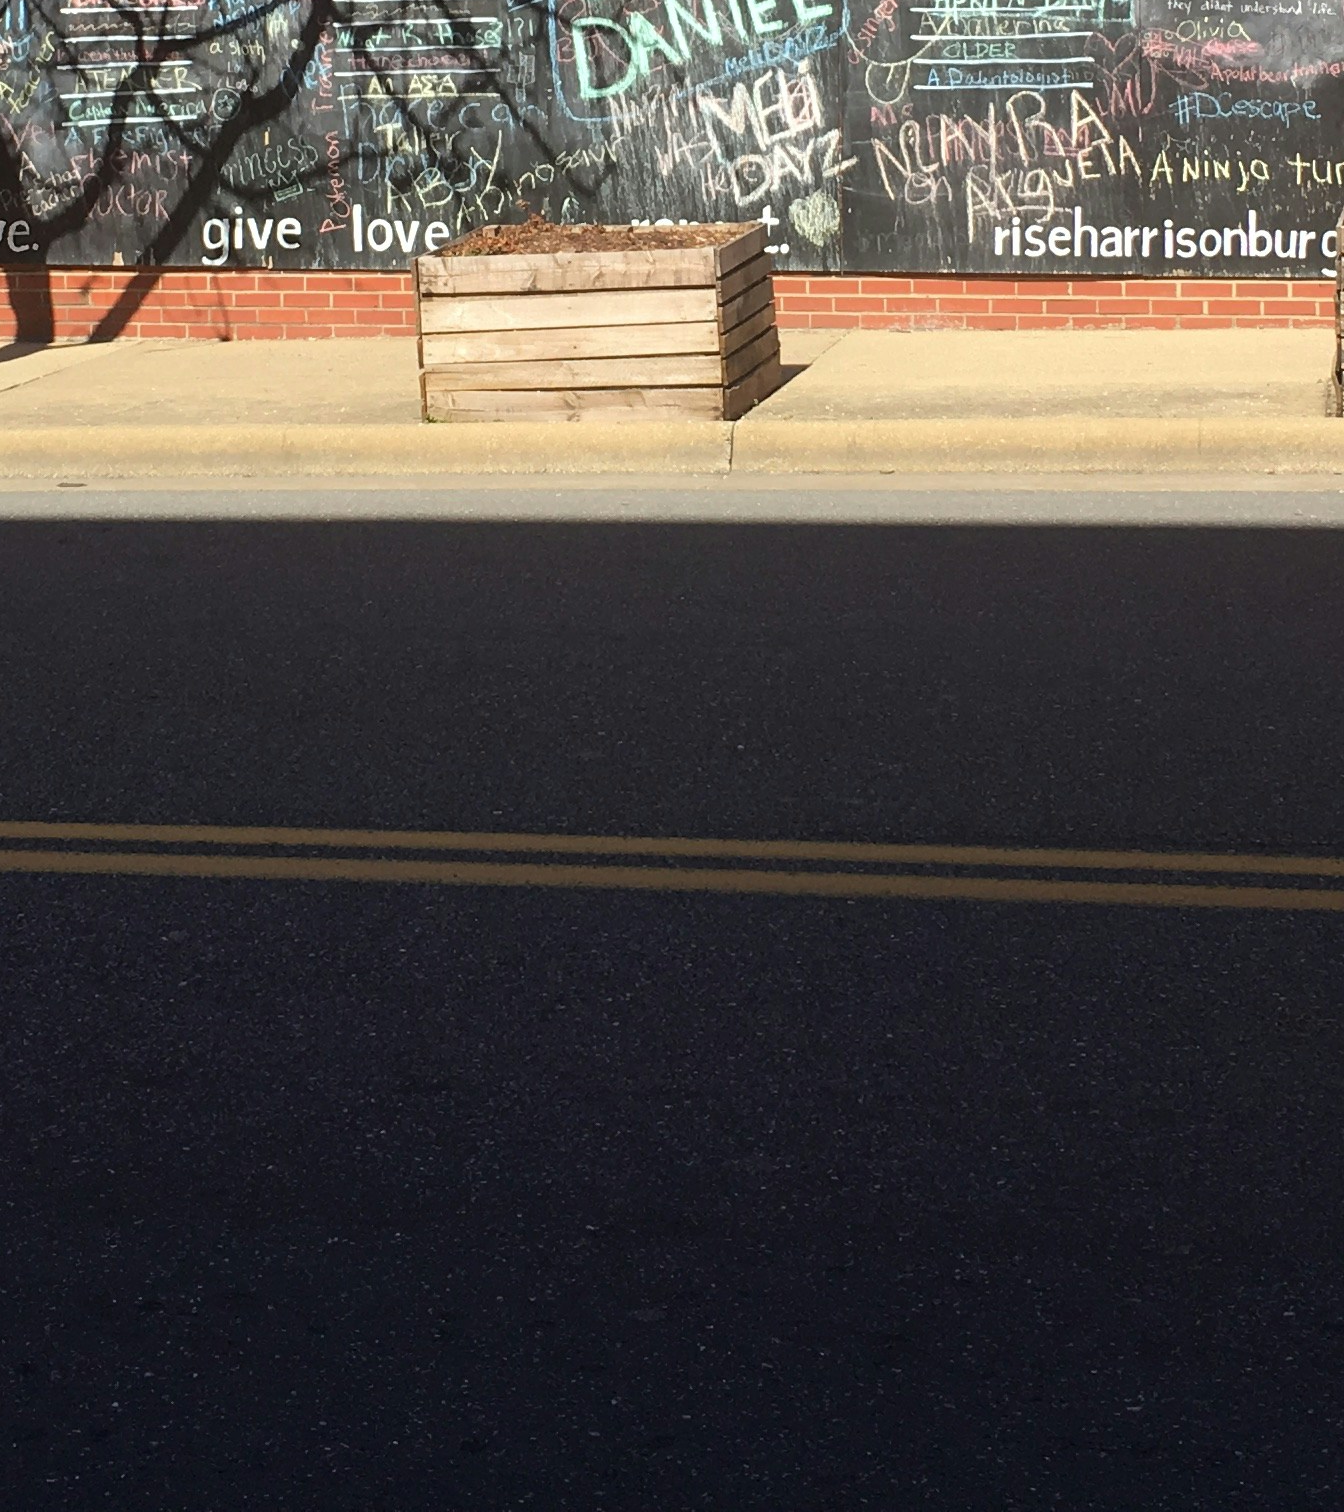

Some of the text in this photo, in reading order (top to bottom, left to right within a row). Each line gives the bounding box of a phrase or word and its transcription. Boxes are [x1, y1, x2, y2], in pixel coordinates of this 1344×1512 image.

[1167, 0, 1193, 17] they
[1240, 2, 1303, 16] understand
[1176, 16, 1253, 42] Olivia
[201, 205, 302, 266] give
[353, 203, 450, 252] love
